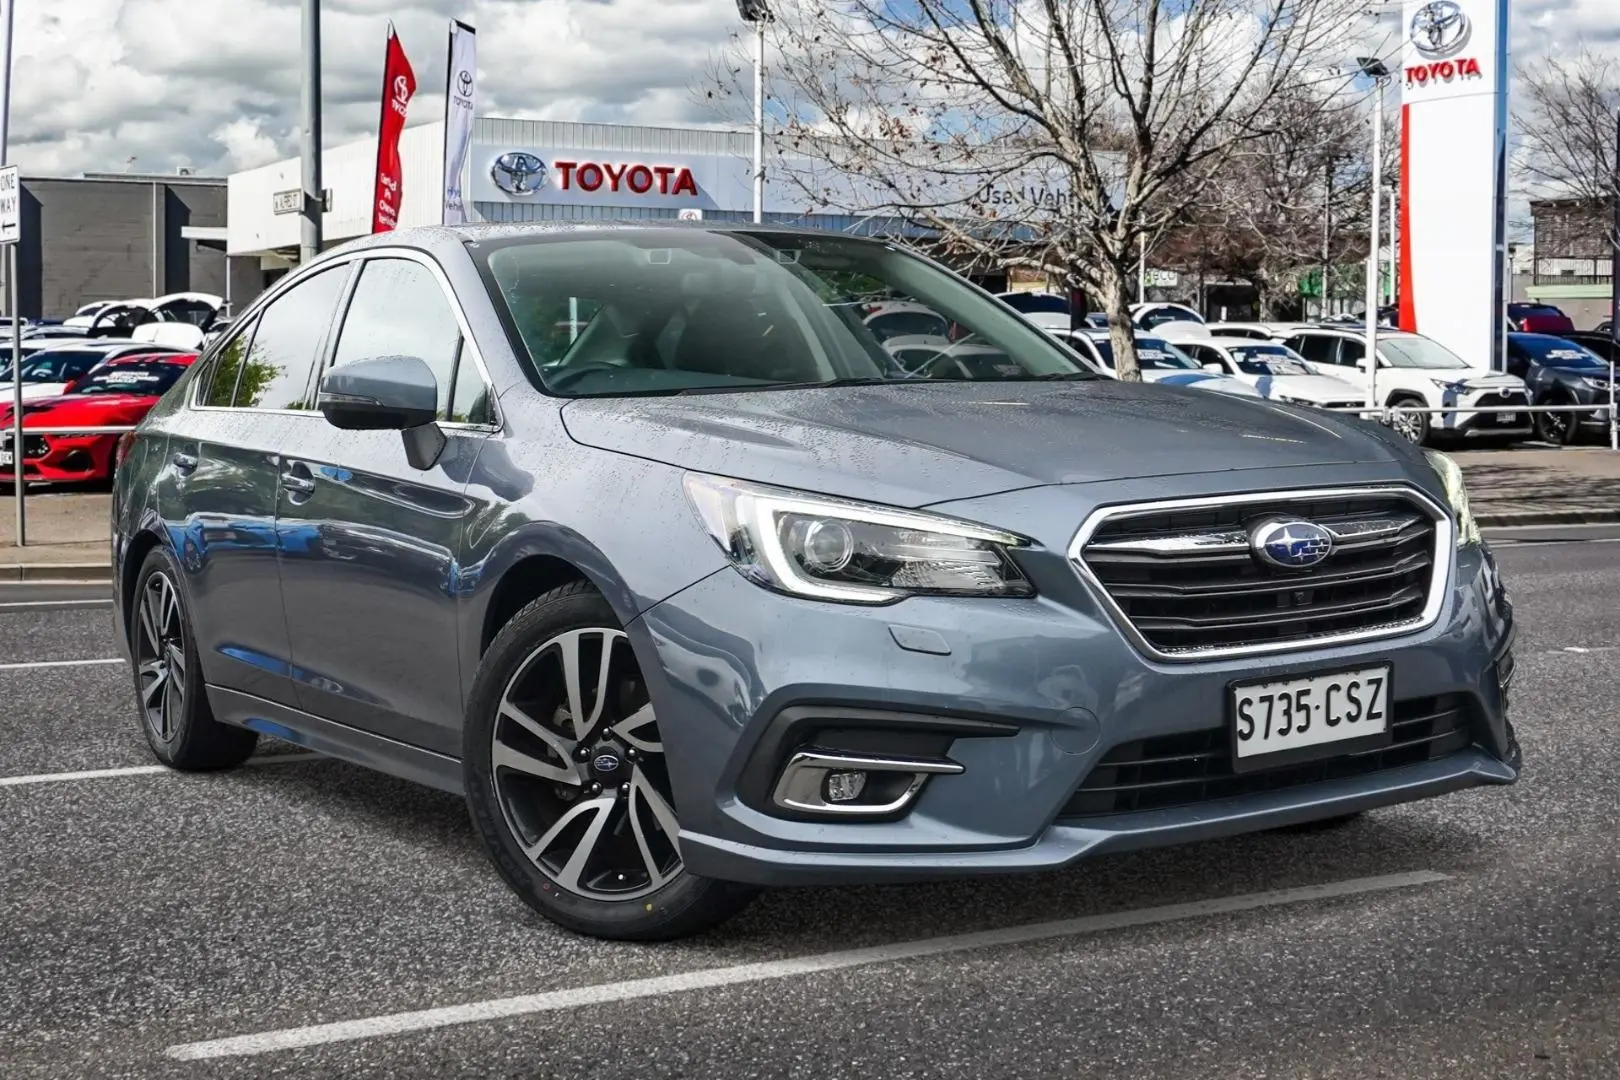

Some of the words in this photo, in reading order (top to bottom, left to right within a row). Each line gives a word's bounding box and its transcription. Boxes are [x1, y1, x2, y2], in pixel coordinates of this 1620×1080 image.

[1404, 58, 1482, 84] TOYOTA
[1, 173, 15, 191] ONE
[555, 161, 698, 196] TOYOTA
[1, 196, 16, 215] WAY
